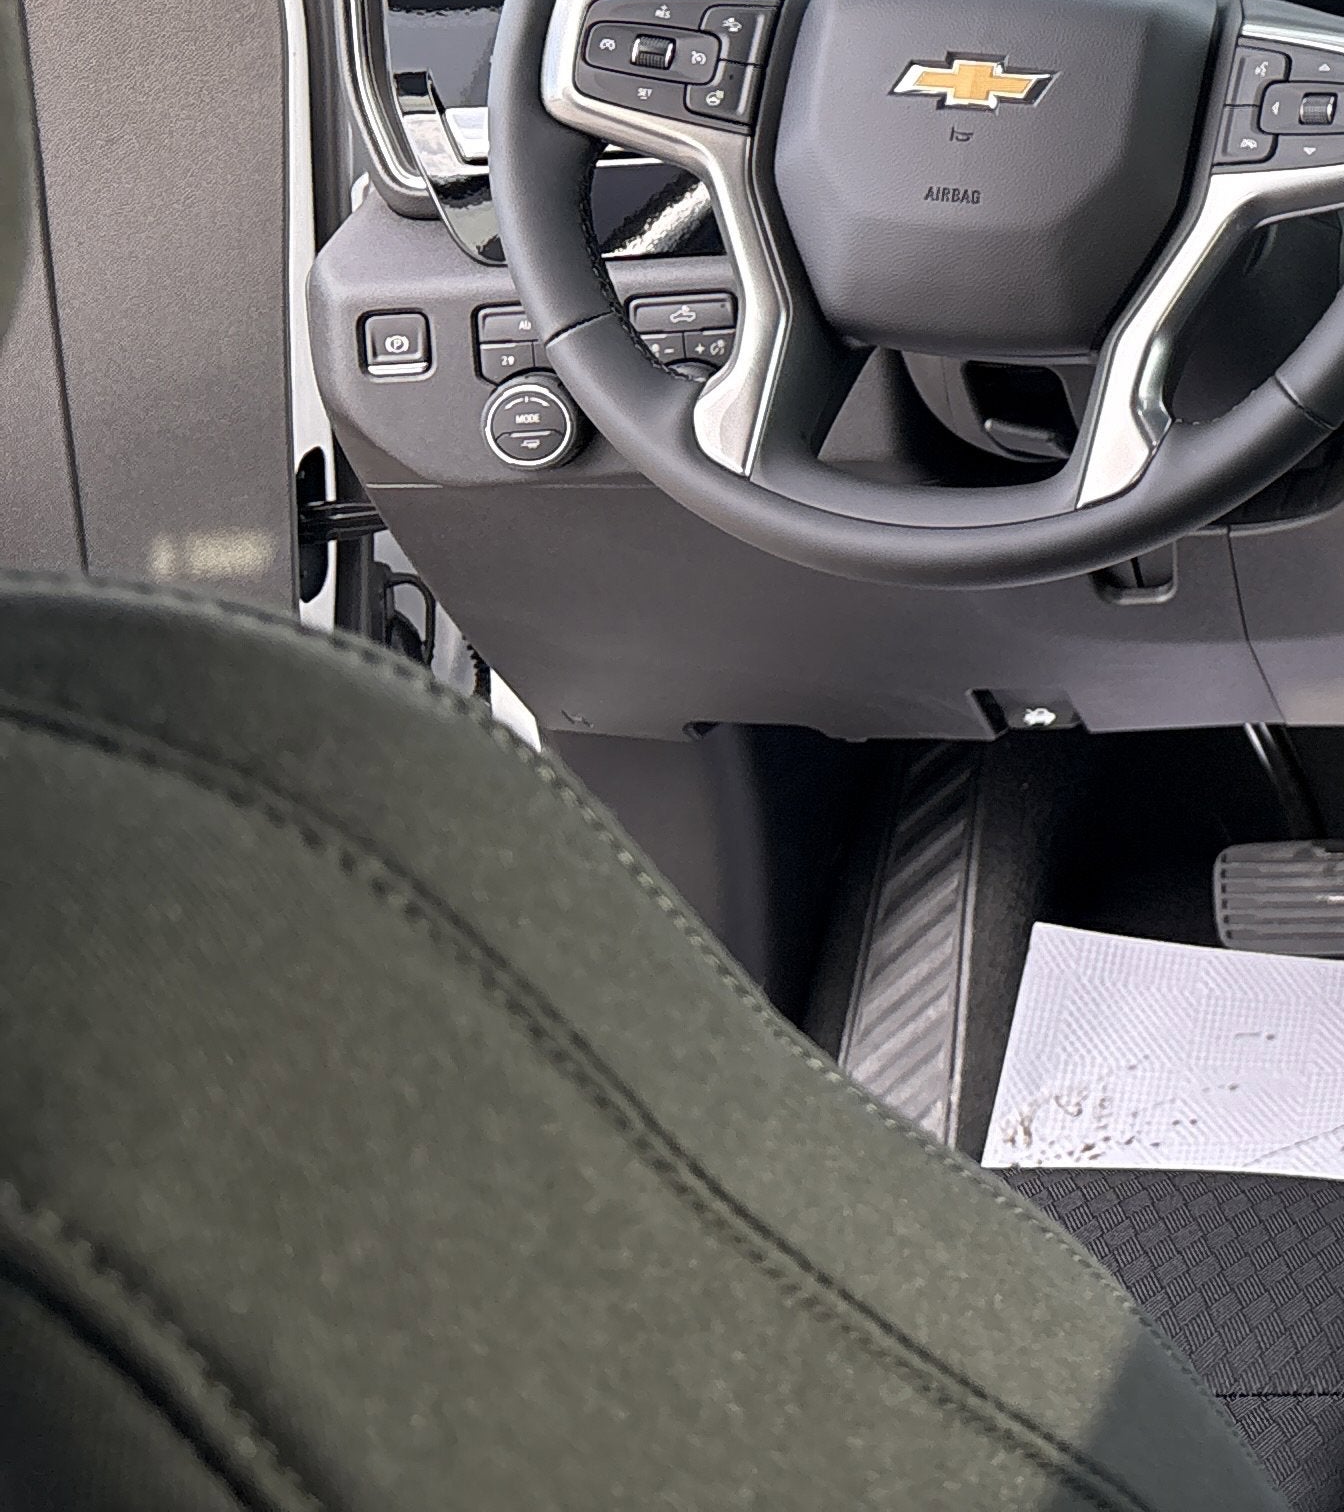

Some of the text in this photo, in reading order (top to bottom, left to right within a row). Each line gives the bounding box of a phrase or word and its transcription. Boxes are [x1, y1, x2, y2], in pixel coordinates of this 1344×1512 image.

[924, 186, 981, 205] AIRBAG
[518, 320, 532, 330] AU
[515, 413, 540, 425] MODE
